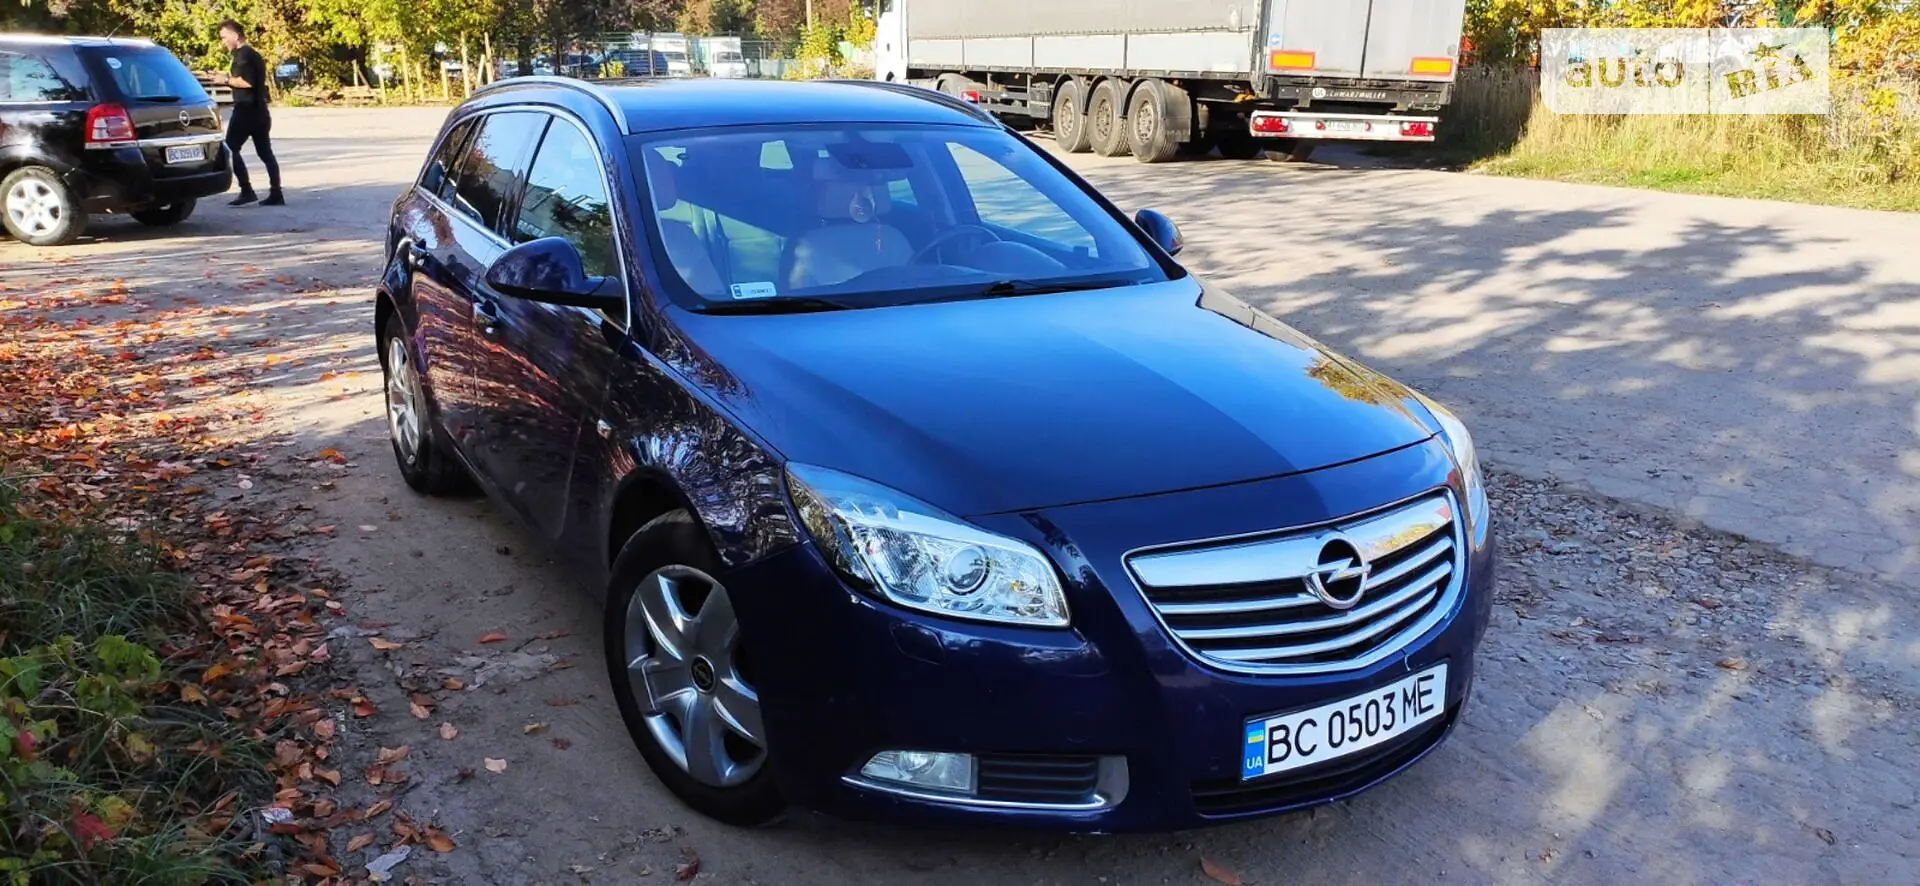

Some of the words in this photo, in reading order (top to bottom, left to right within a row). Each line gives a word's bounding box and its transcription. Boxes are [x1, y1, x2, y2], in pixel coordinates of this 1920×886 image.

[1267, 718, 1318, 765] BC
[1327, 691, 1396, 749] 0503
[1402, 674, 1435, 724] ME
[1246, 757, 1263, 769] UA
